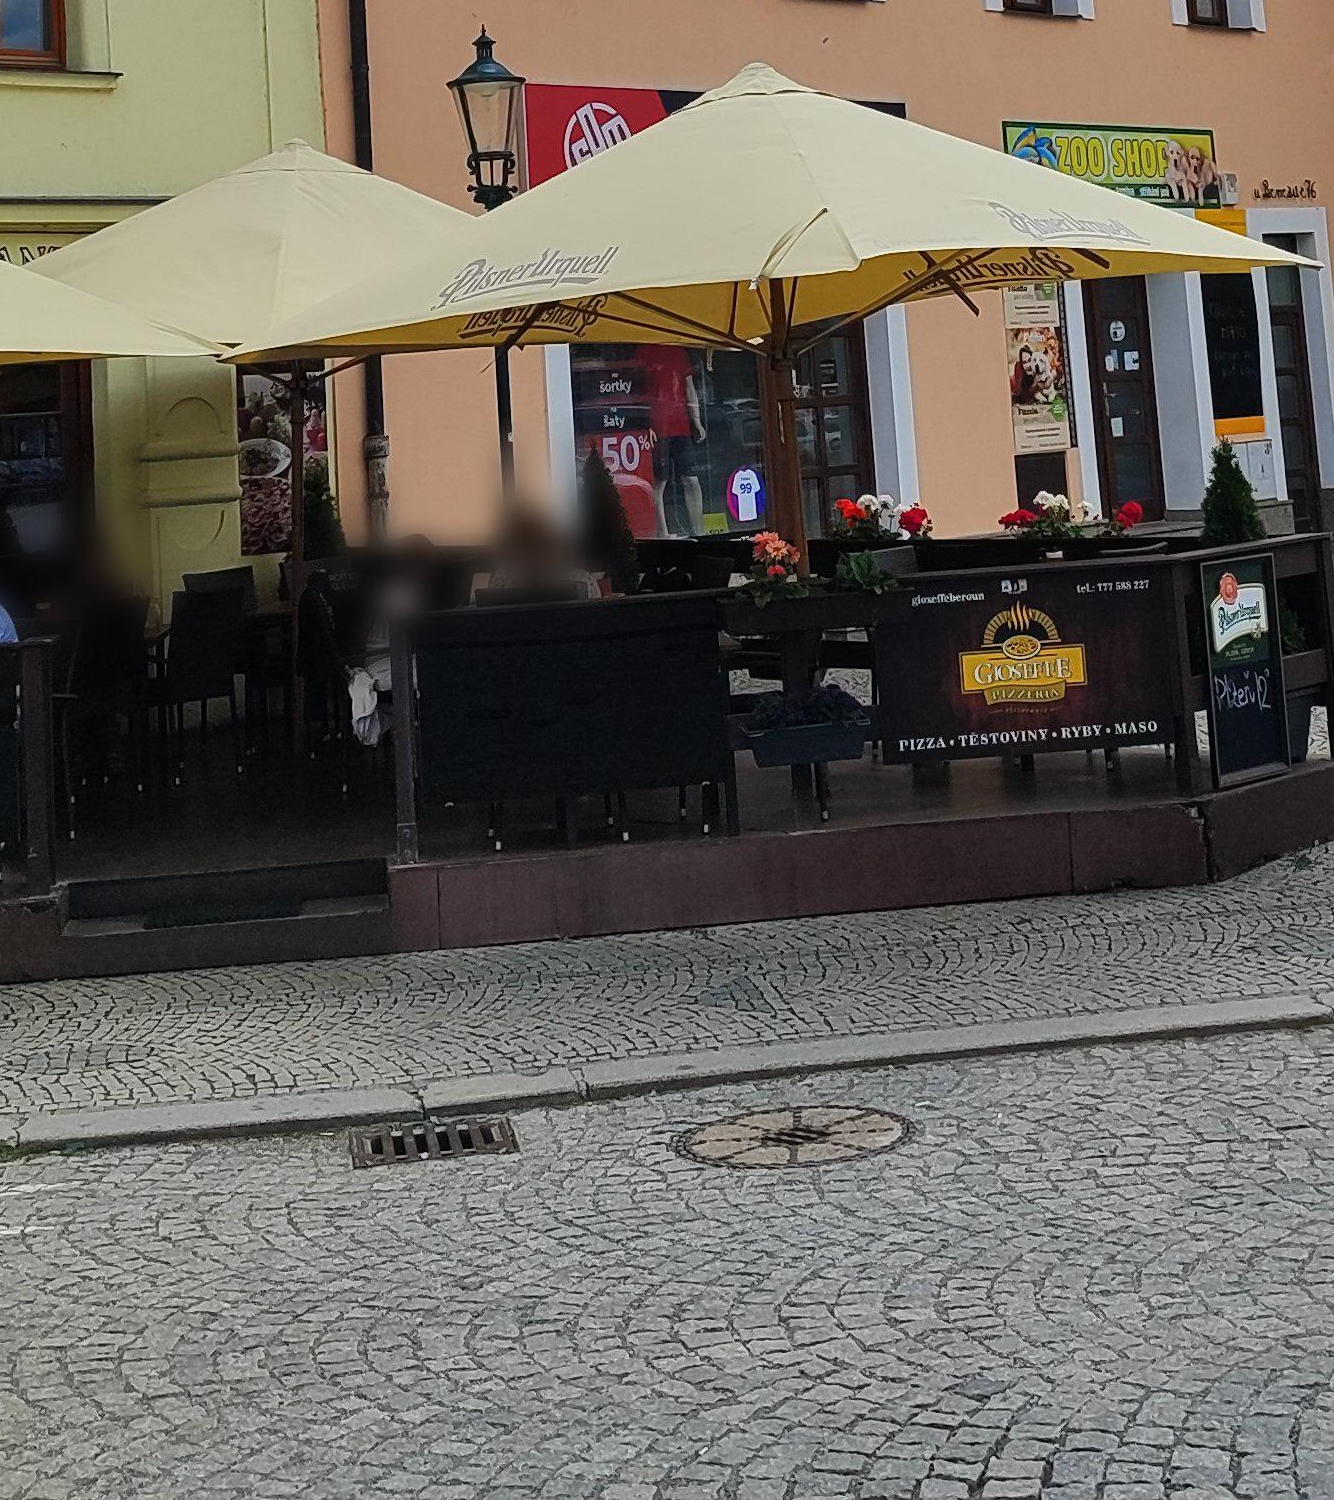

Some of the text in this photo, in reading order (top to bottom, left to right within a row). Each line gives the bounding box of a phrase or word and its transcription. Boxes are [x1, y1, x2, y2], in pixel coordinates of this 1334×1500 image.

[1054, 136, 1105, 177] ZOO
[599, 379, 632, 394] šortky
[740, 482, 752, 494] 99
[1133, 579, 1150, 590] 227
[974, 657, 1073, 684] GIOSEFFE
[992, 688, 1060, 700] PIZZERIA
[899, 720, 1159, 752] PIZZA TĚSTOVINY RYBY MASO
